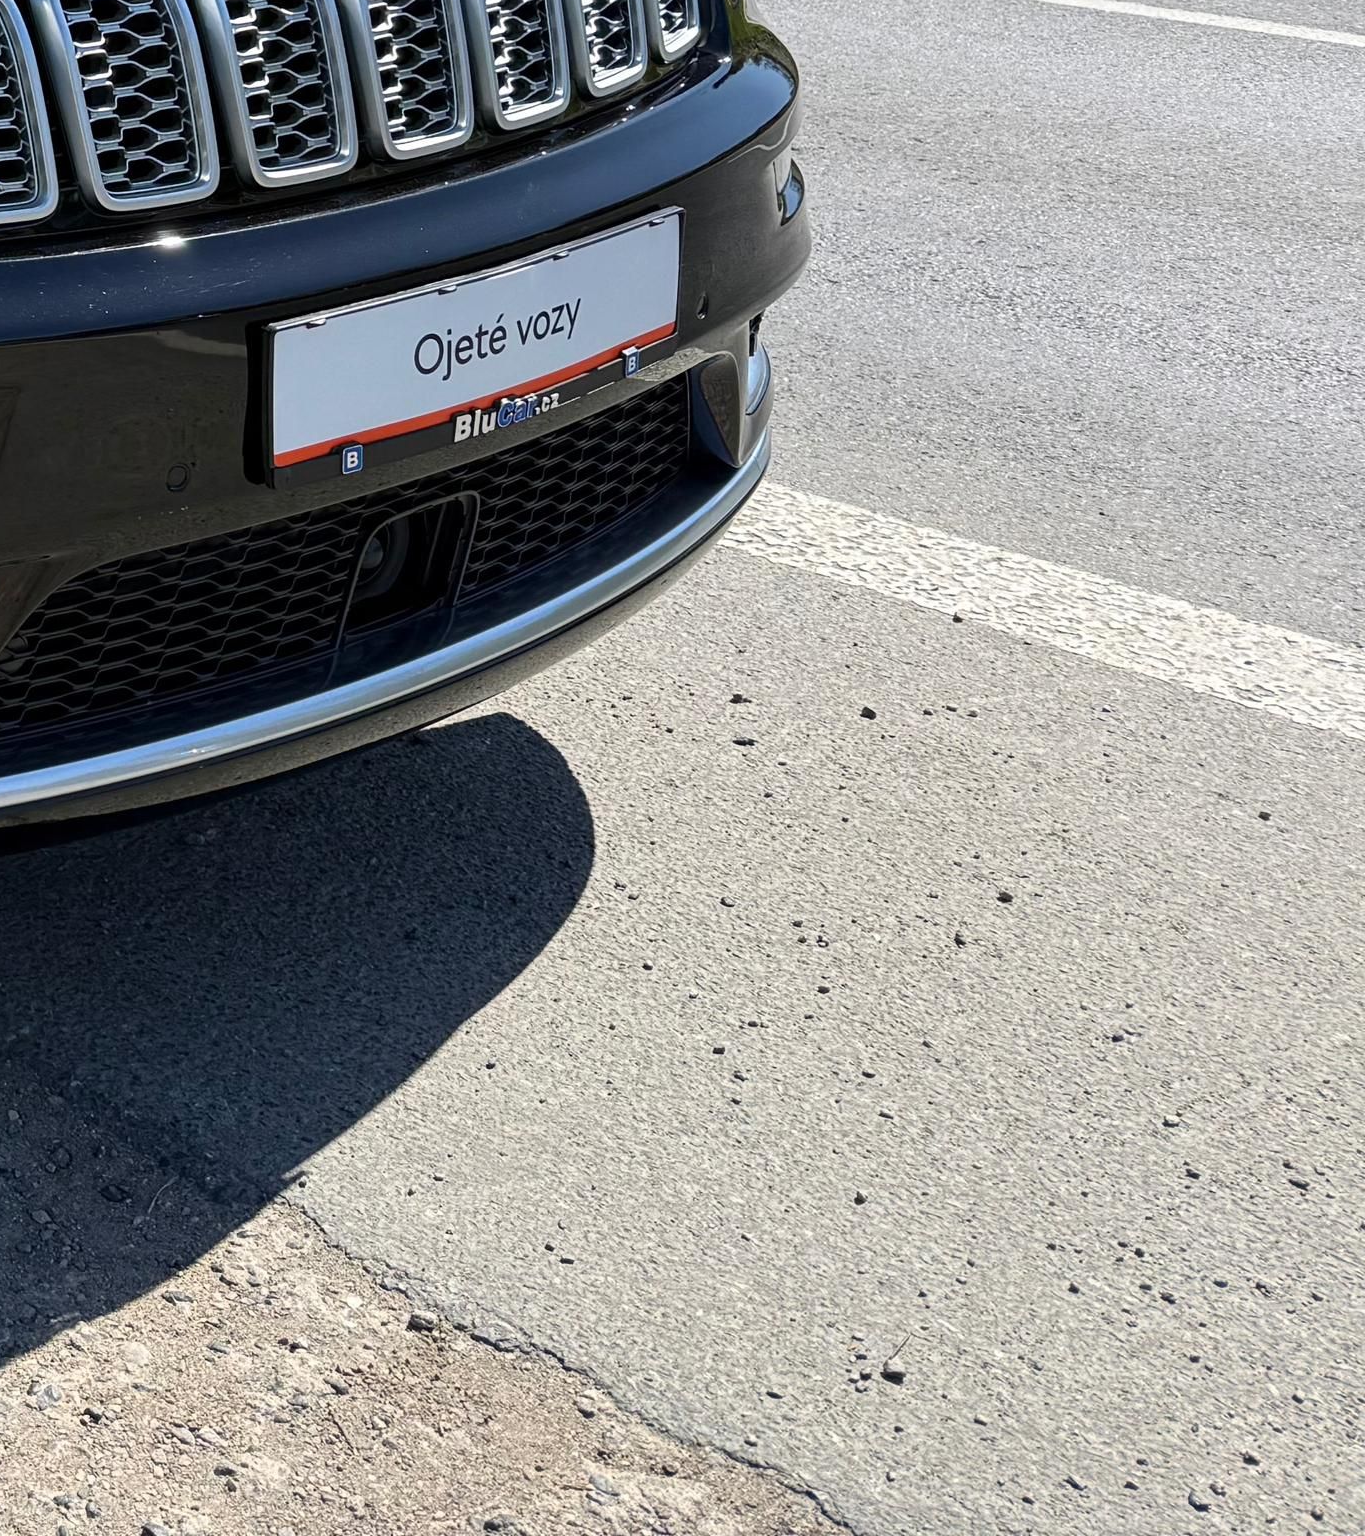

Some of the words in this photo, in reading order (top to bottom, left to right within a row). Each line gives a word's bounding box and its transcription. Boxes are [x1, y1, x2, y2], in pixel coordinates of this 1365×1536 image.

[414, 313, 507, 381] Ojeté
[517, 298, 581, 345] vozy
[453, 392, 560, 443] BluCar.cz
